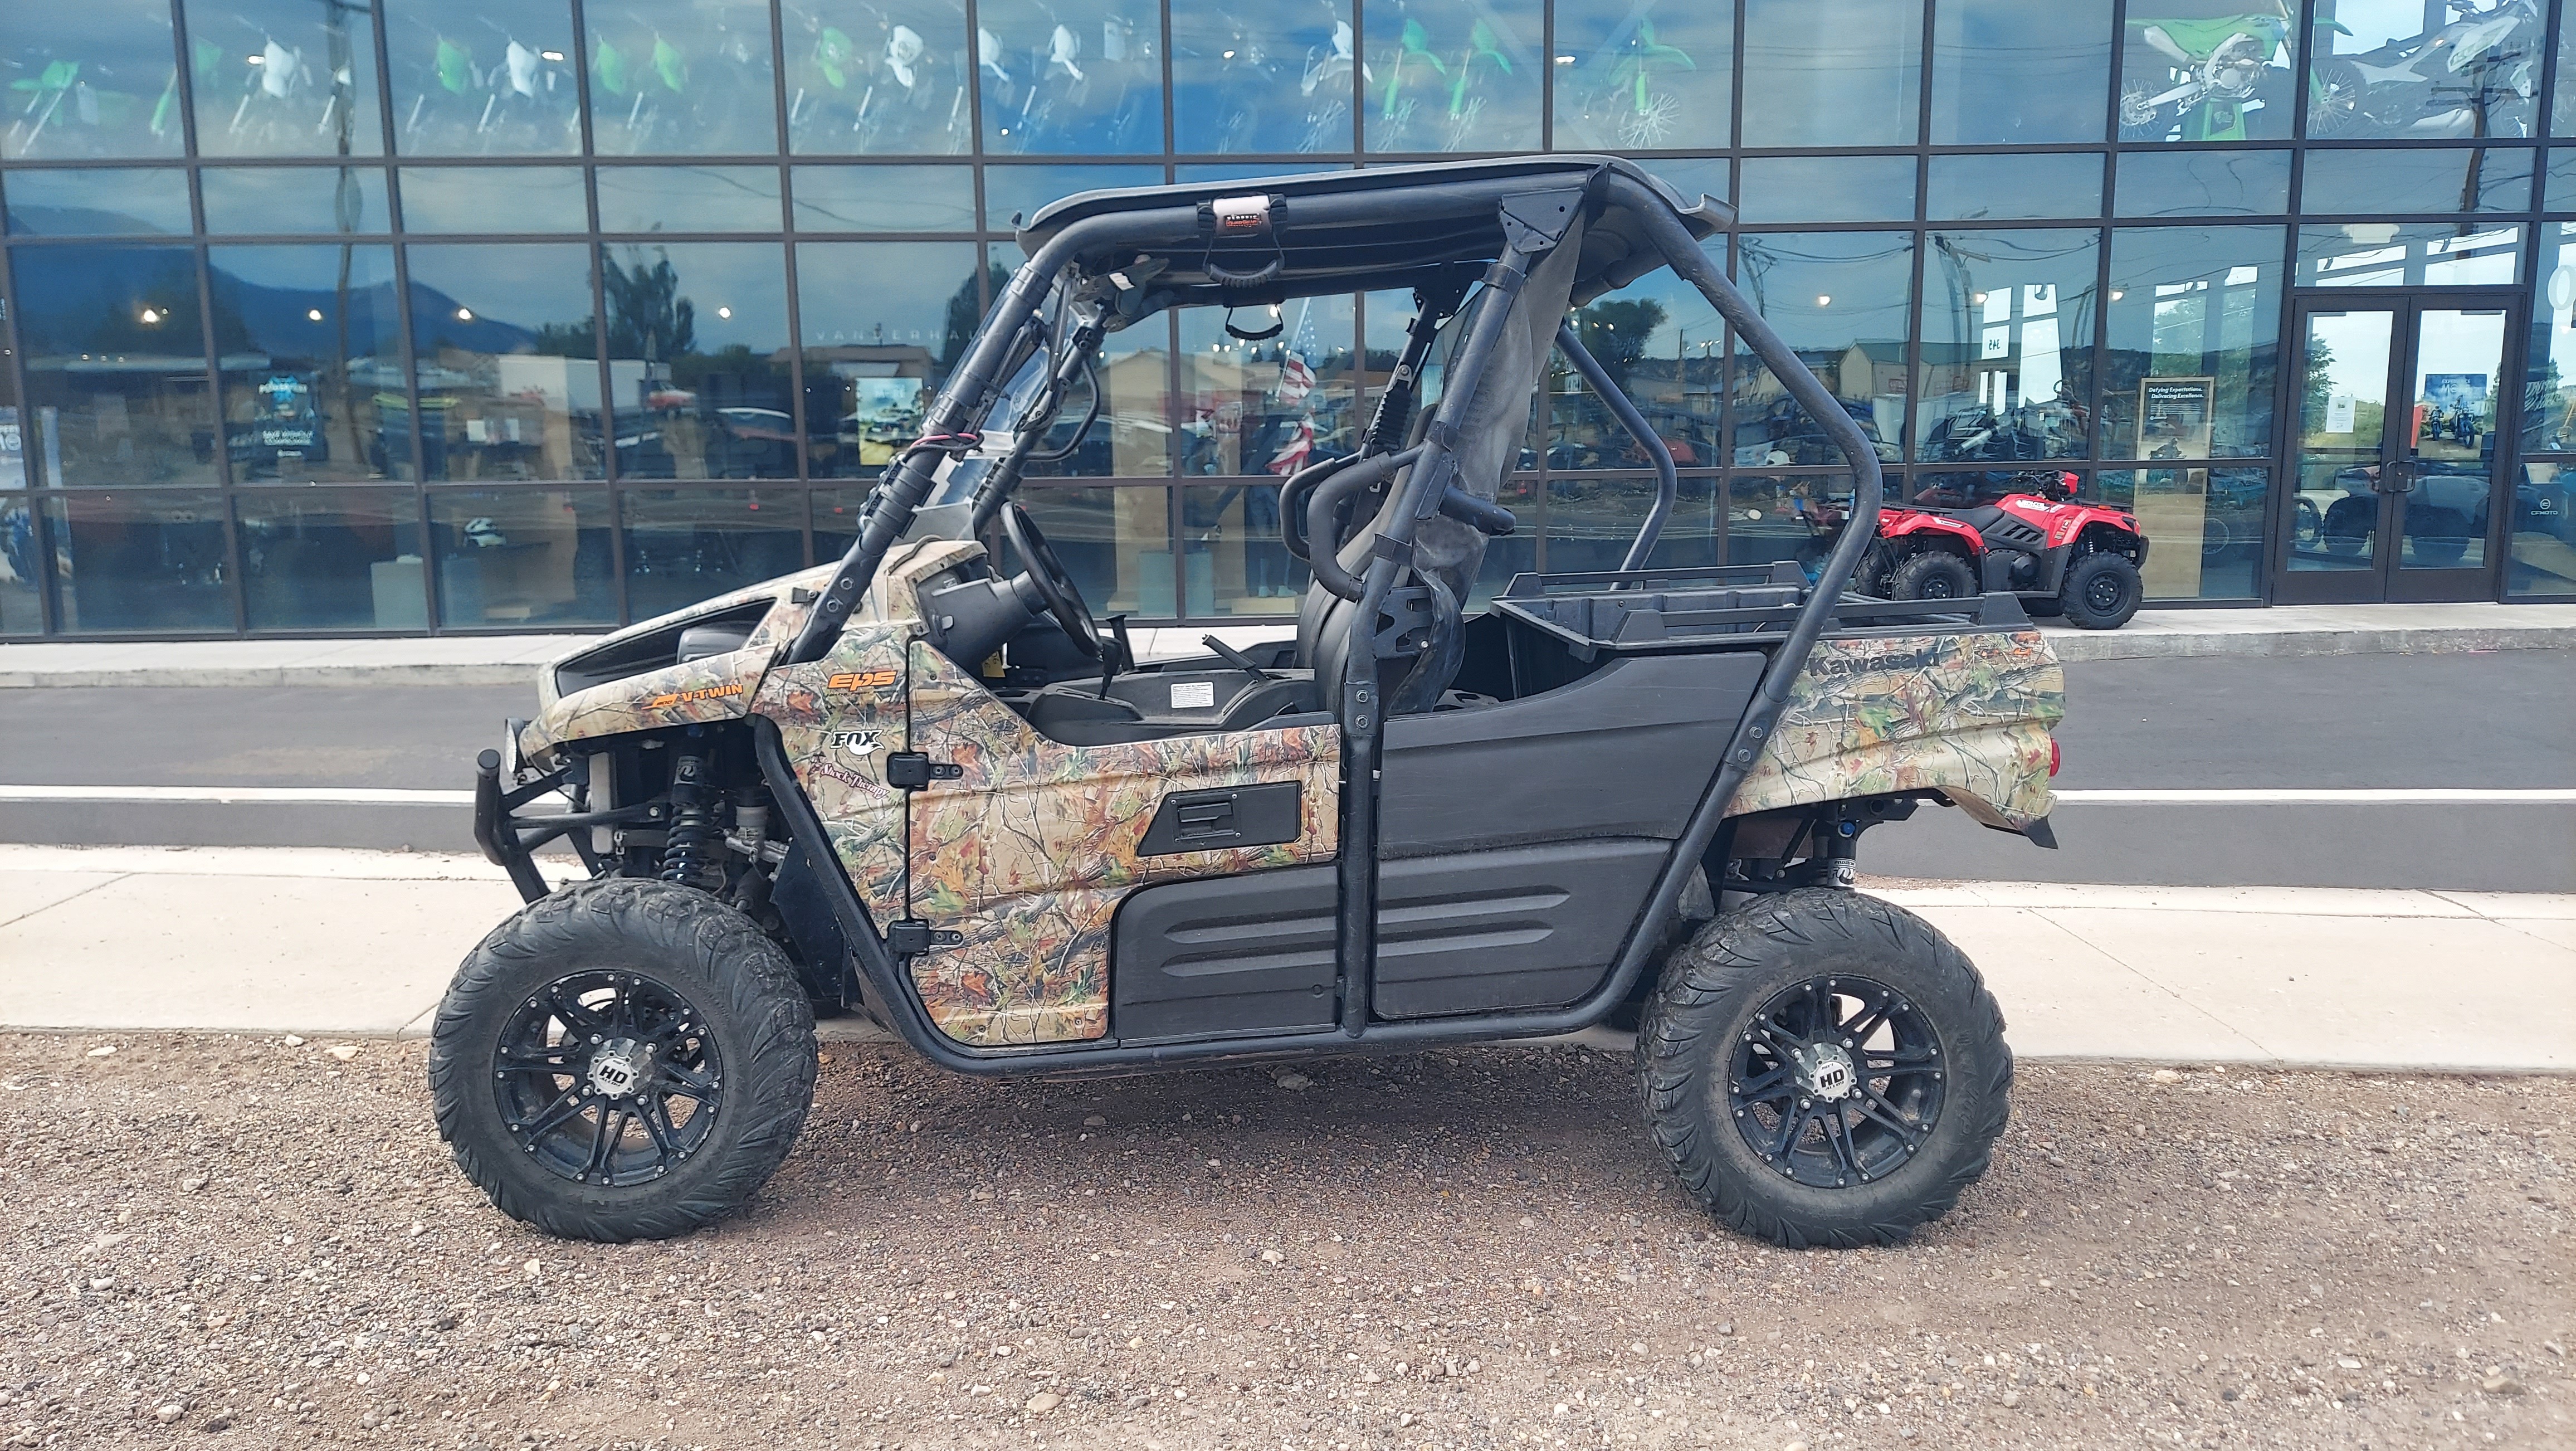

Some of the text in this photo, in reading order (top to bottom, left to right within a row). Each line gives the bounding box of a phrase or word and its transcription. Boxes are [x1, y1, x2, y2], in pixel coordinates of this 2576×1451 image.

[1809, 648, 1940, 676] Kawasaki
[681, 683, 744, 703] V-TWIN
[830, 729, 884, 751] FOX
[821, 762, 890, 800] Shock Therapy
[599, 1065, 628, 1084] HD
[1819, 1068, 1845, 1089] HD
